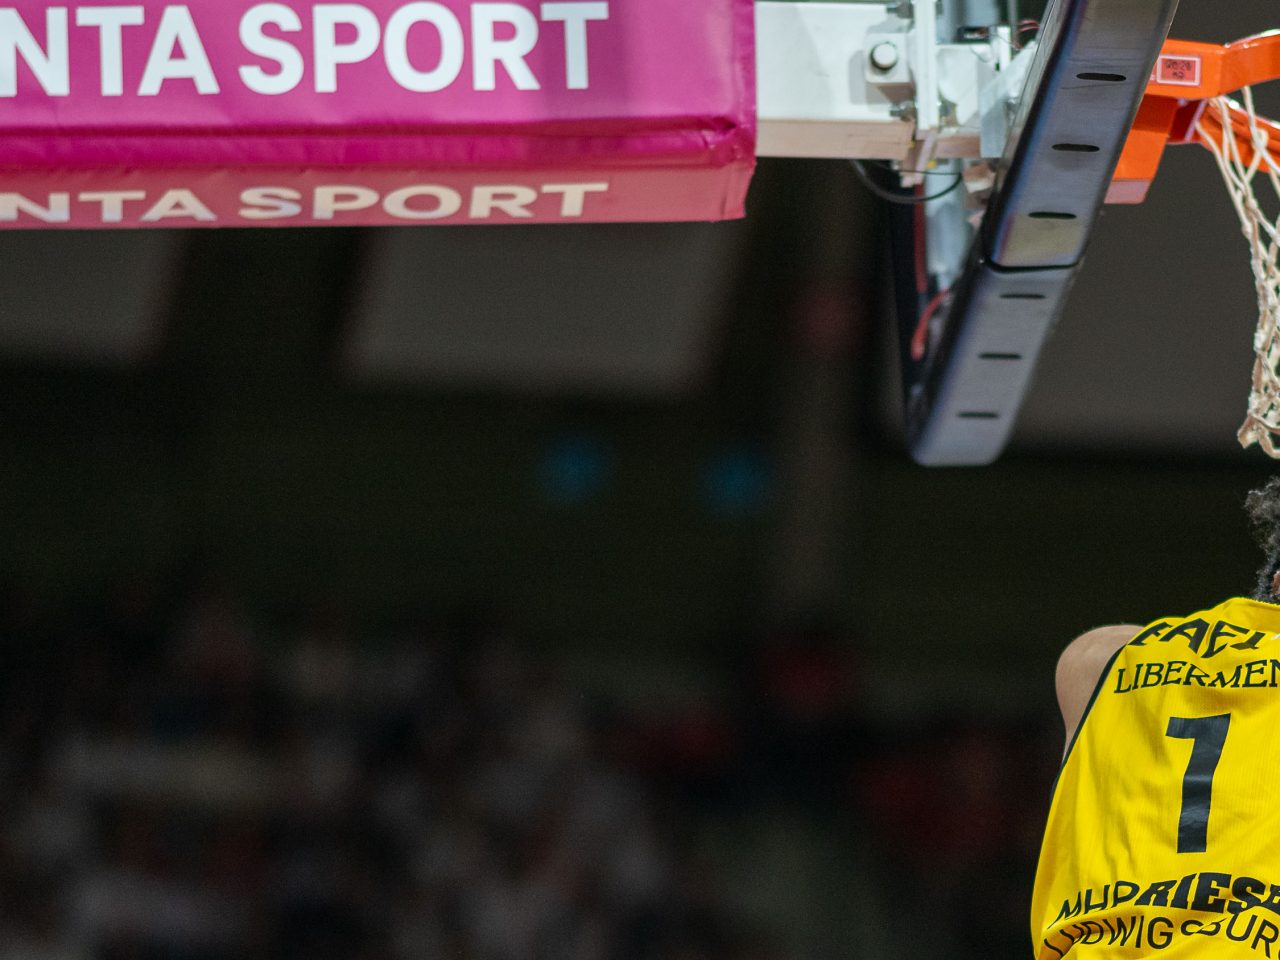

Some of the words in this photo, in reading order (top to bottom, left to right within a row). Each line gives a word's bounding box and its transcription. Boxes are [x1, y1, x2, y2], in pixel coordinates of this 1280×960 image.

[238, 1, 609, 95] SPORT
[238, 182, 609, 220] SPORT
[1165, 713, 1231, 853] 1
